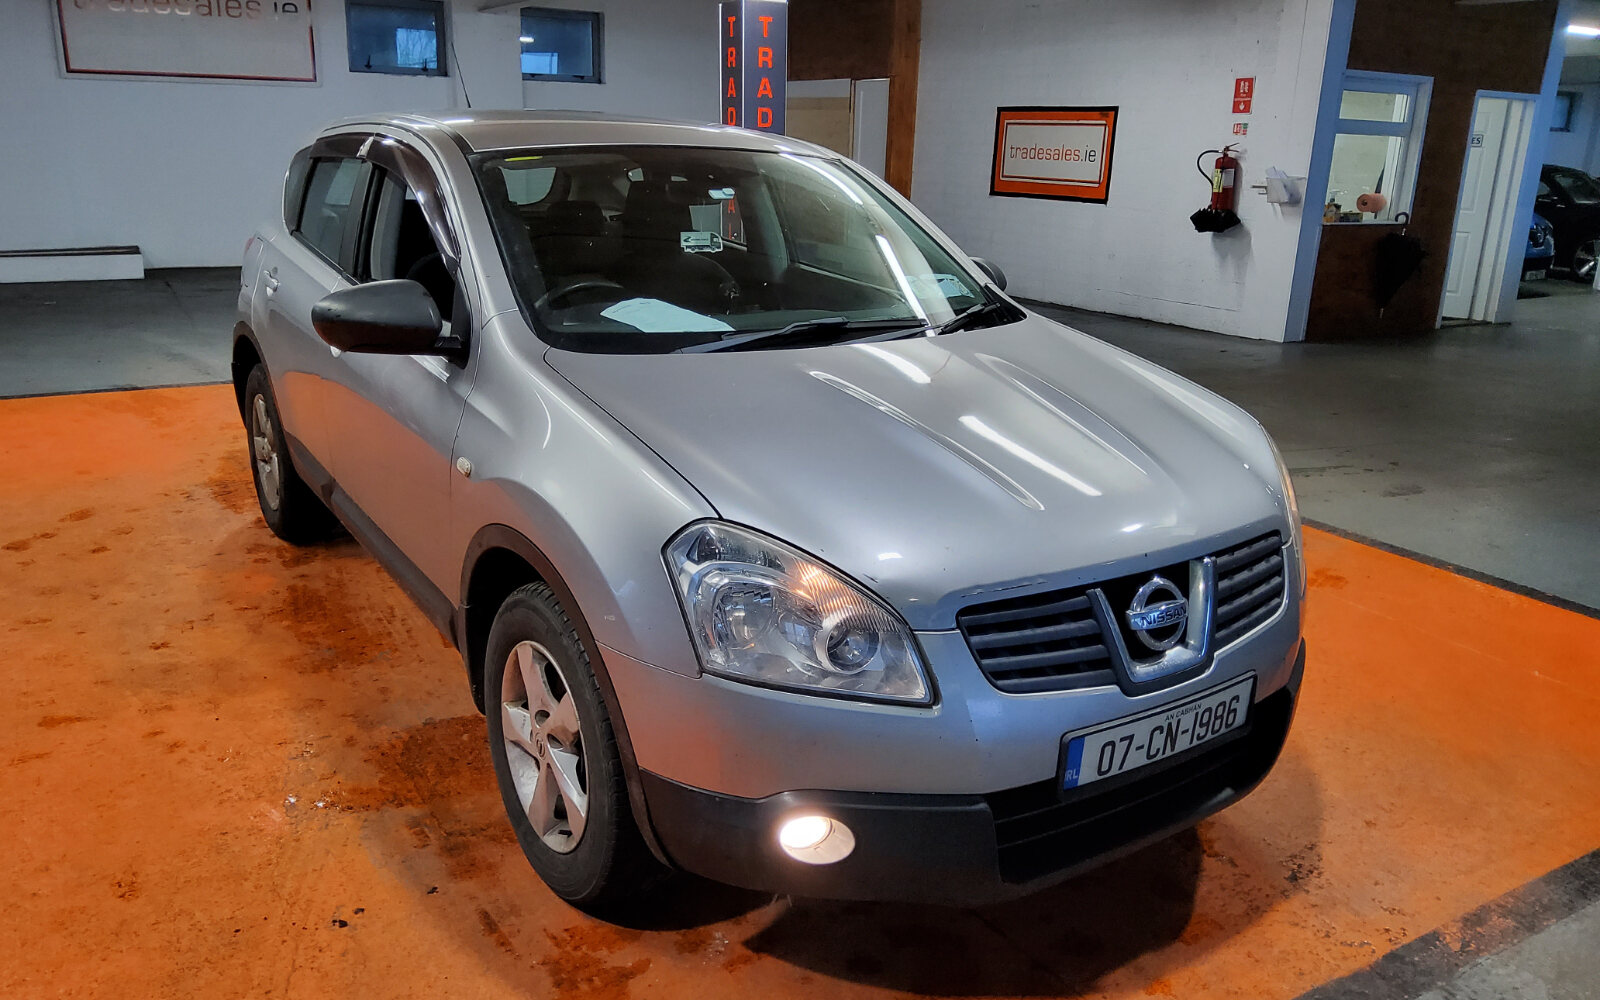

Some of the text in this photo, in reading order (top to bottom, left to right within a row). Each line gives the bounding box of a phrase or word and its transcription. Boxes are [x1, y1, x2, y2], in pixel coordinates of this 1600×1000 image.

[727, 16, 736, 126] TRAD
[757, 16, 773, 128] TRAD
[1009, 143, 1097, 163] tradesales.ie
[1141, 605, 1187, 627] NISSAN
[1097, 694, 1240, 777] 07-CN-1986
[1165, 713, 1175, 722] AN
